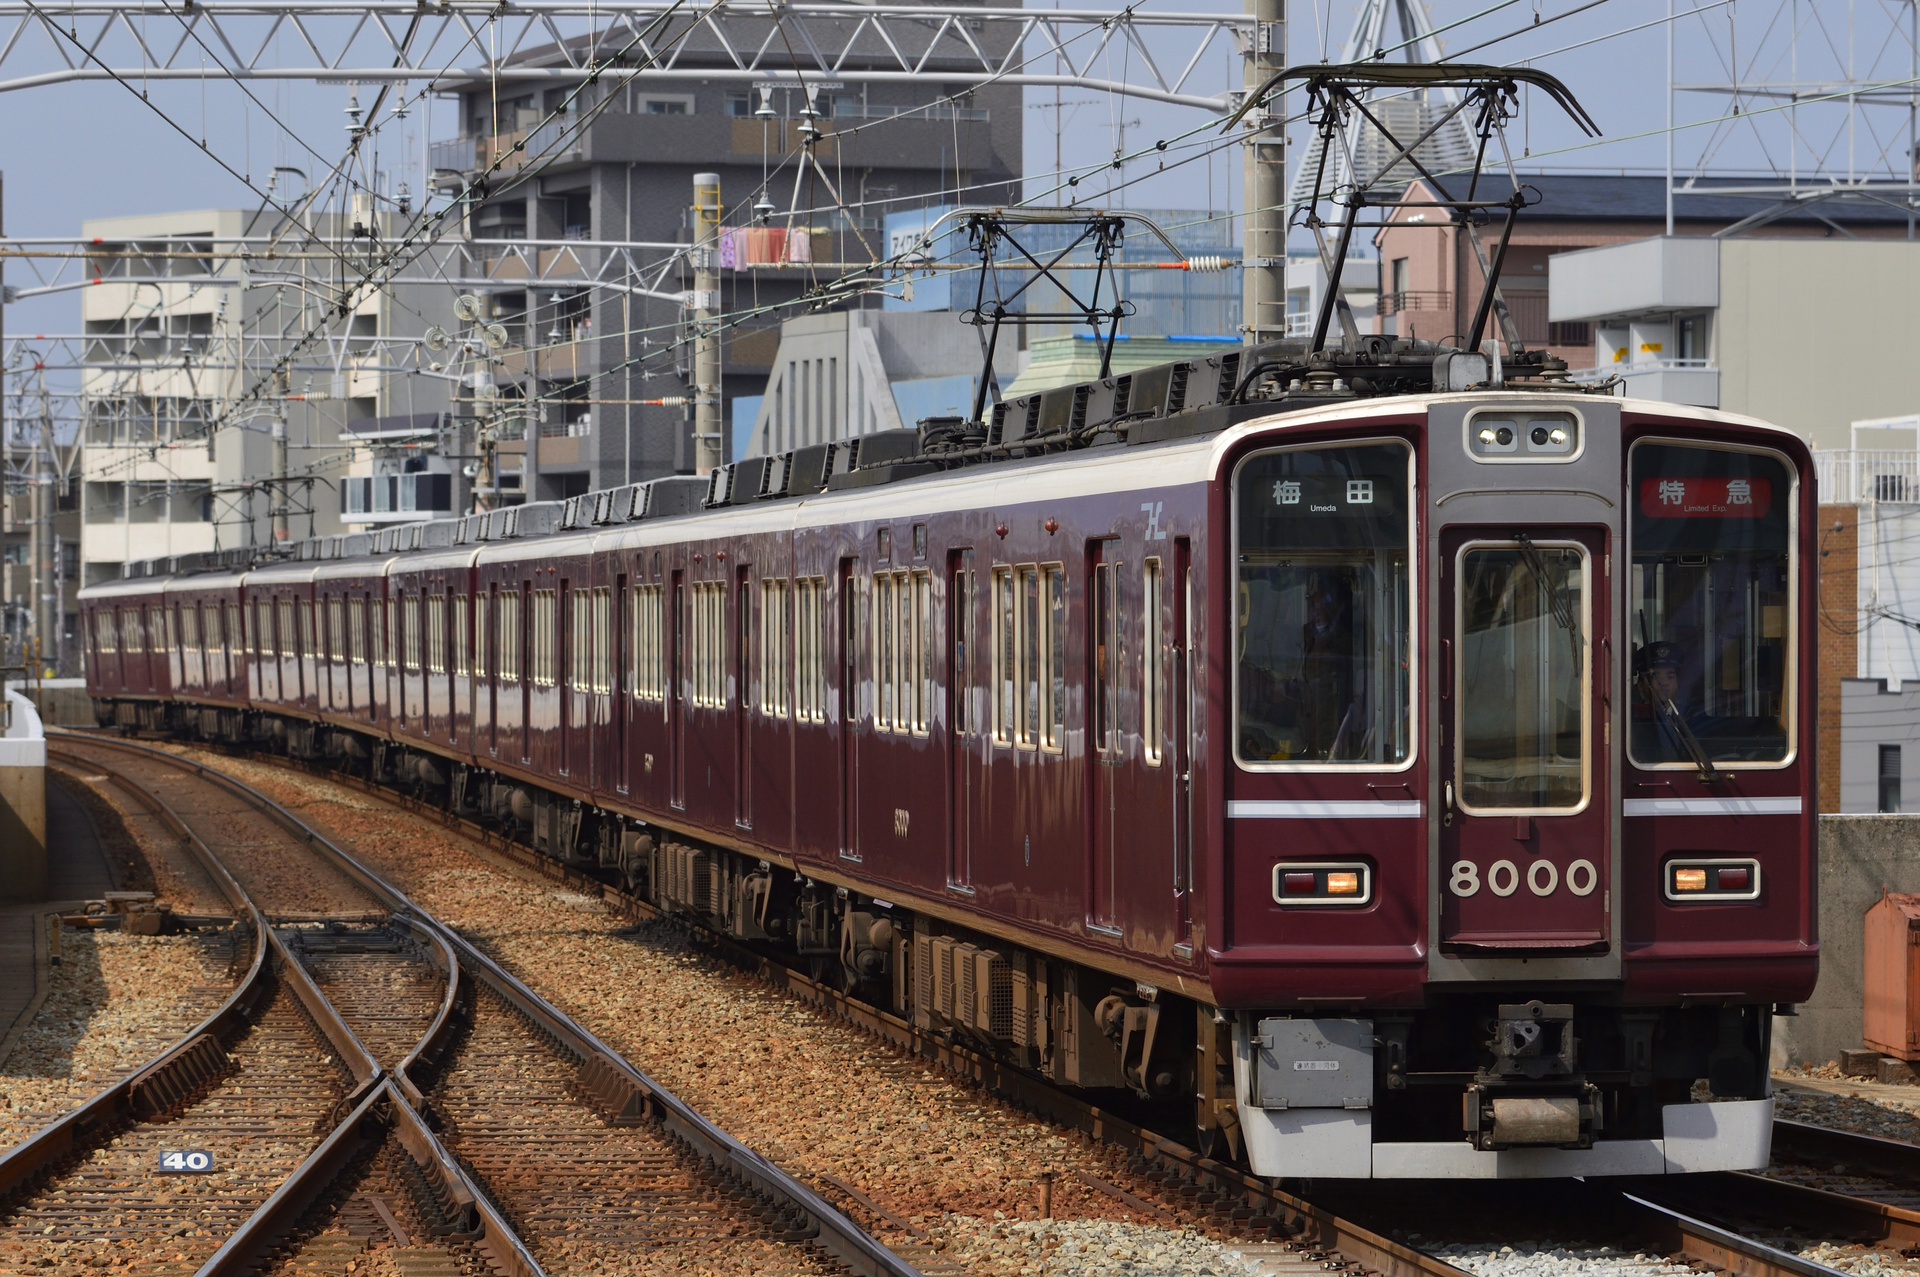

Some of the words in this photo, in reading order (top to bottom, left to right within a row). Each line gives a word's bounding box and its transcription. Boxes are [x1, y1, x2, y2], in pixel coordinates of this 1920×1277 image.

[1272, 480, 1374, 505] 梅田
[1658, 479, 1753, 505] 特急
[1310, 504, 1337, 512] Umeda
[1712, 505, 1728, 513] Exp.
[1449, 859, 1597, 897] 8000
[163, 1152, 209, 1170] 40
